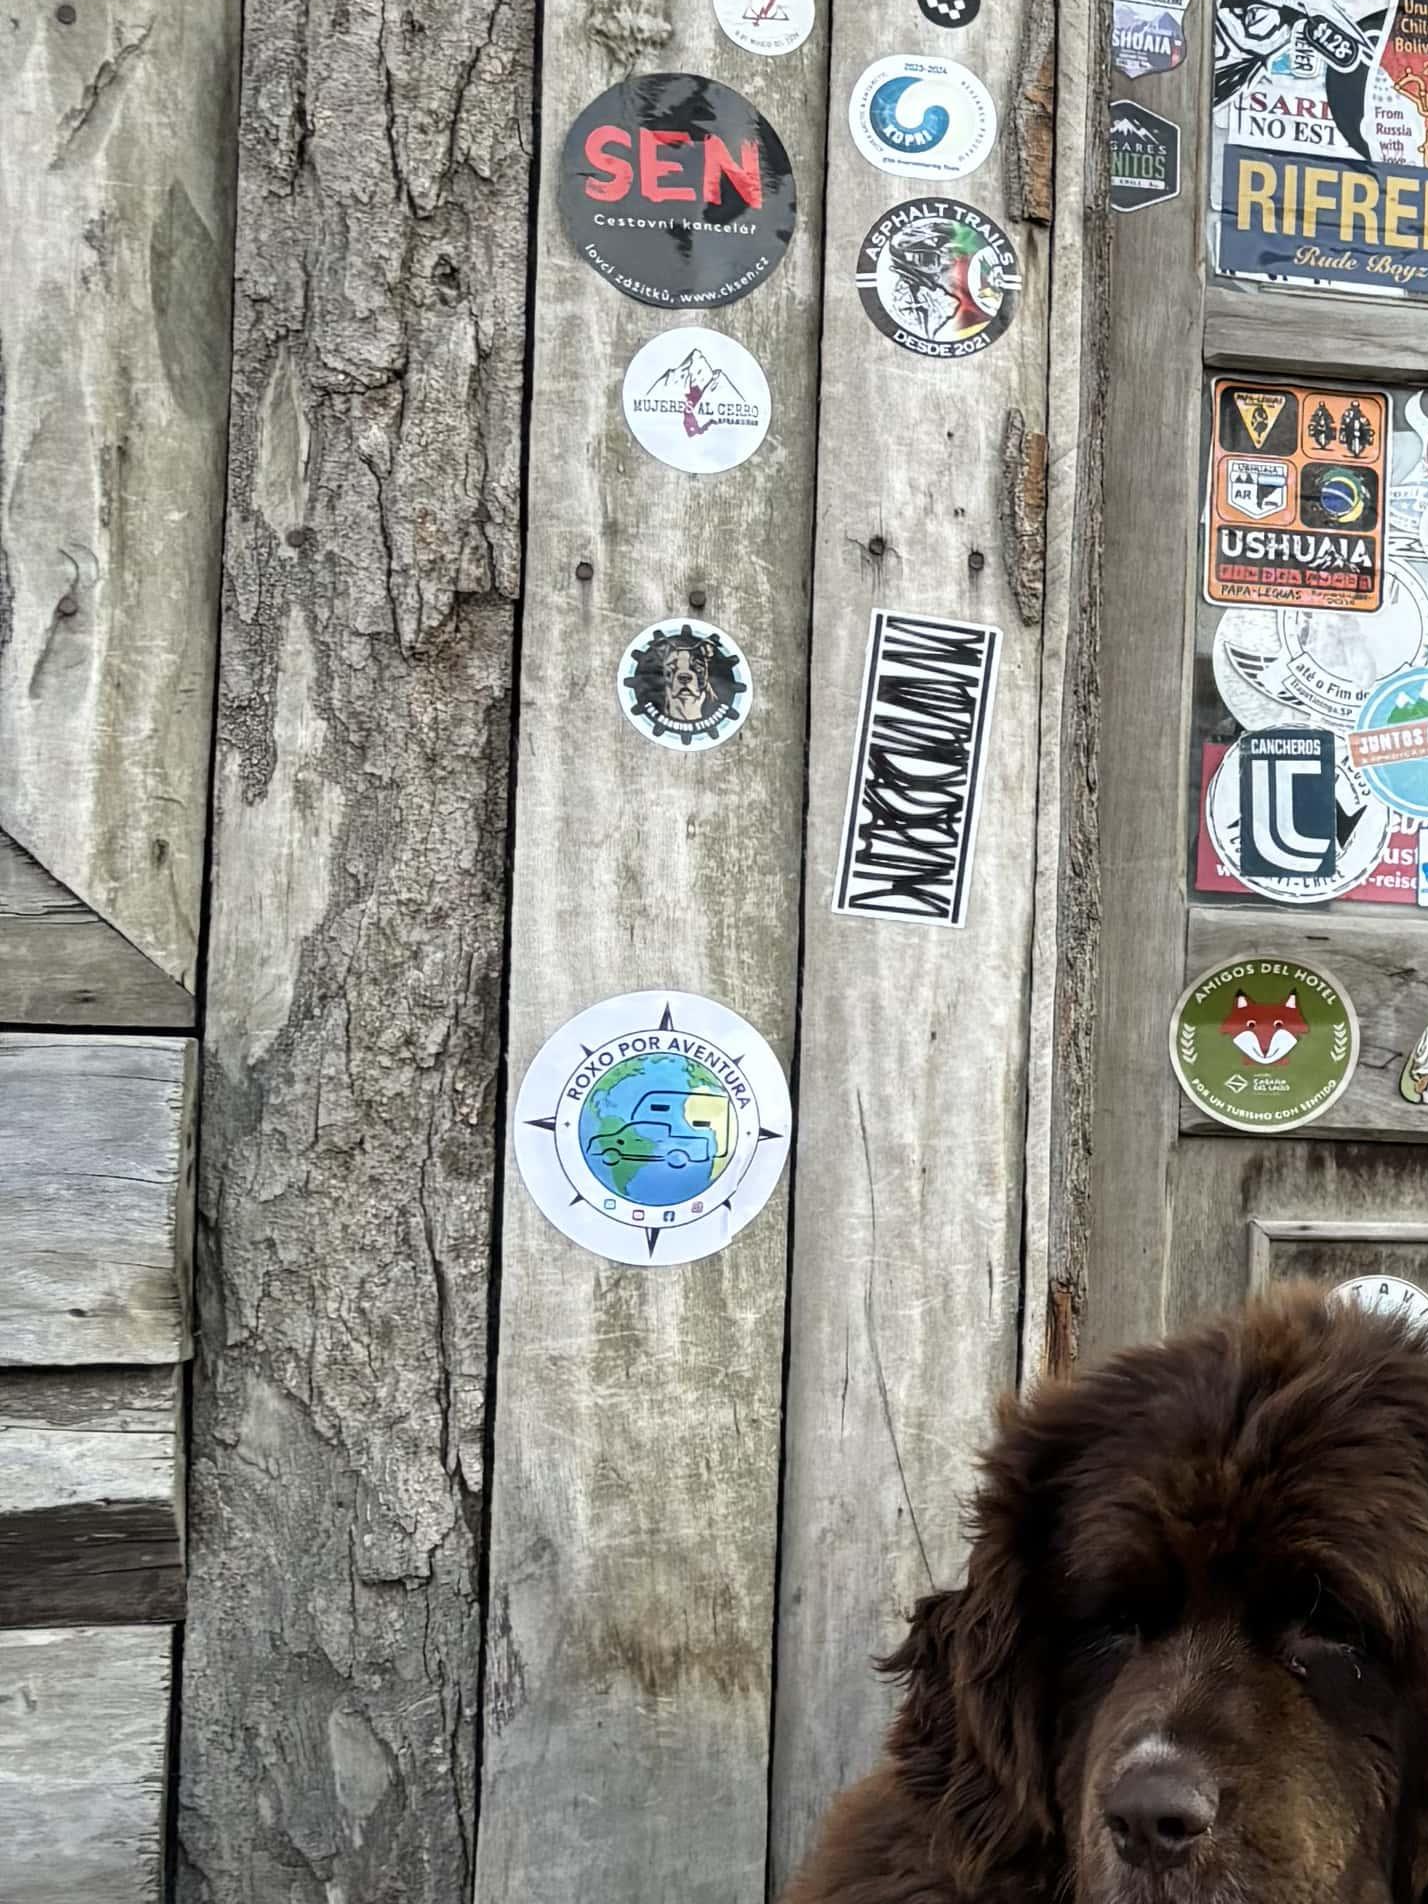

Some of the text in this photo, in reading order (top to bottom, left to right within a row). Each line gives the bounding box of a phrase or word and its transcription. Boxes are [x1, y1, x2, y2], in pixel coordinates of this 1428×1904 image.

[1374, 107, 1404, 120] From
[1375, 122, 1413, 139] Russia
[1379, 139, 1404, 154] with
[584, 125, 763, 209] SEN
[594, 213, 758, 236] Cestovní kancelář
[865, 203, 1016, 267] ASPHALT TRAILS
[1294, 245, 1359, 272] Rude
[893, 329, 991, 358] DESDE 2021
[633, 401, 759, 418] MUJERES AL CERRO
[1219, 529, 1373, 570] USHUAIA
[1250, 737, 1322, 757] CANCHEROS
[1194, 961, 1338, 1007] AMIGOS DEL HOTEL
[567, 1035, 751, 1112] ROXO POR AVENTURA
